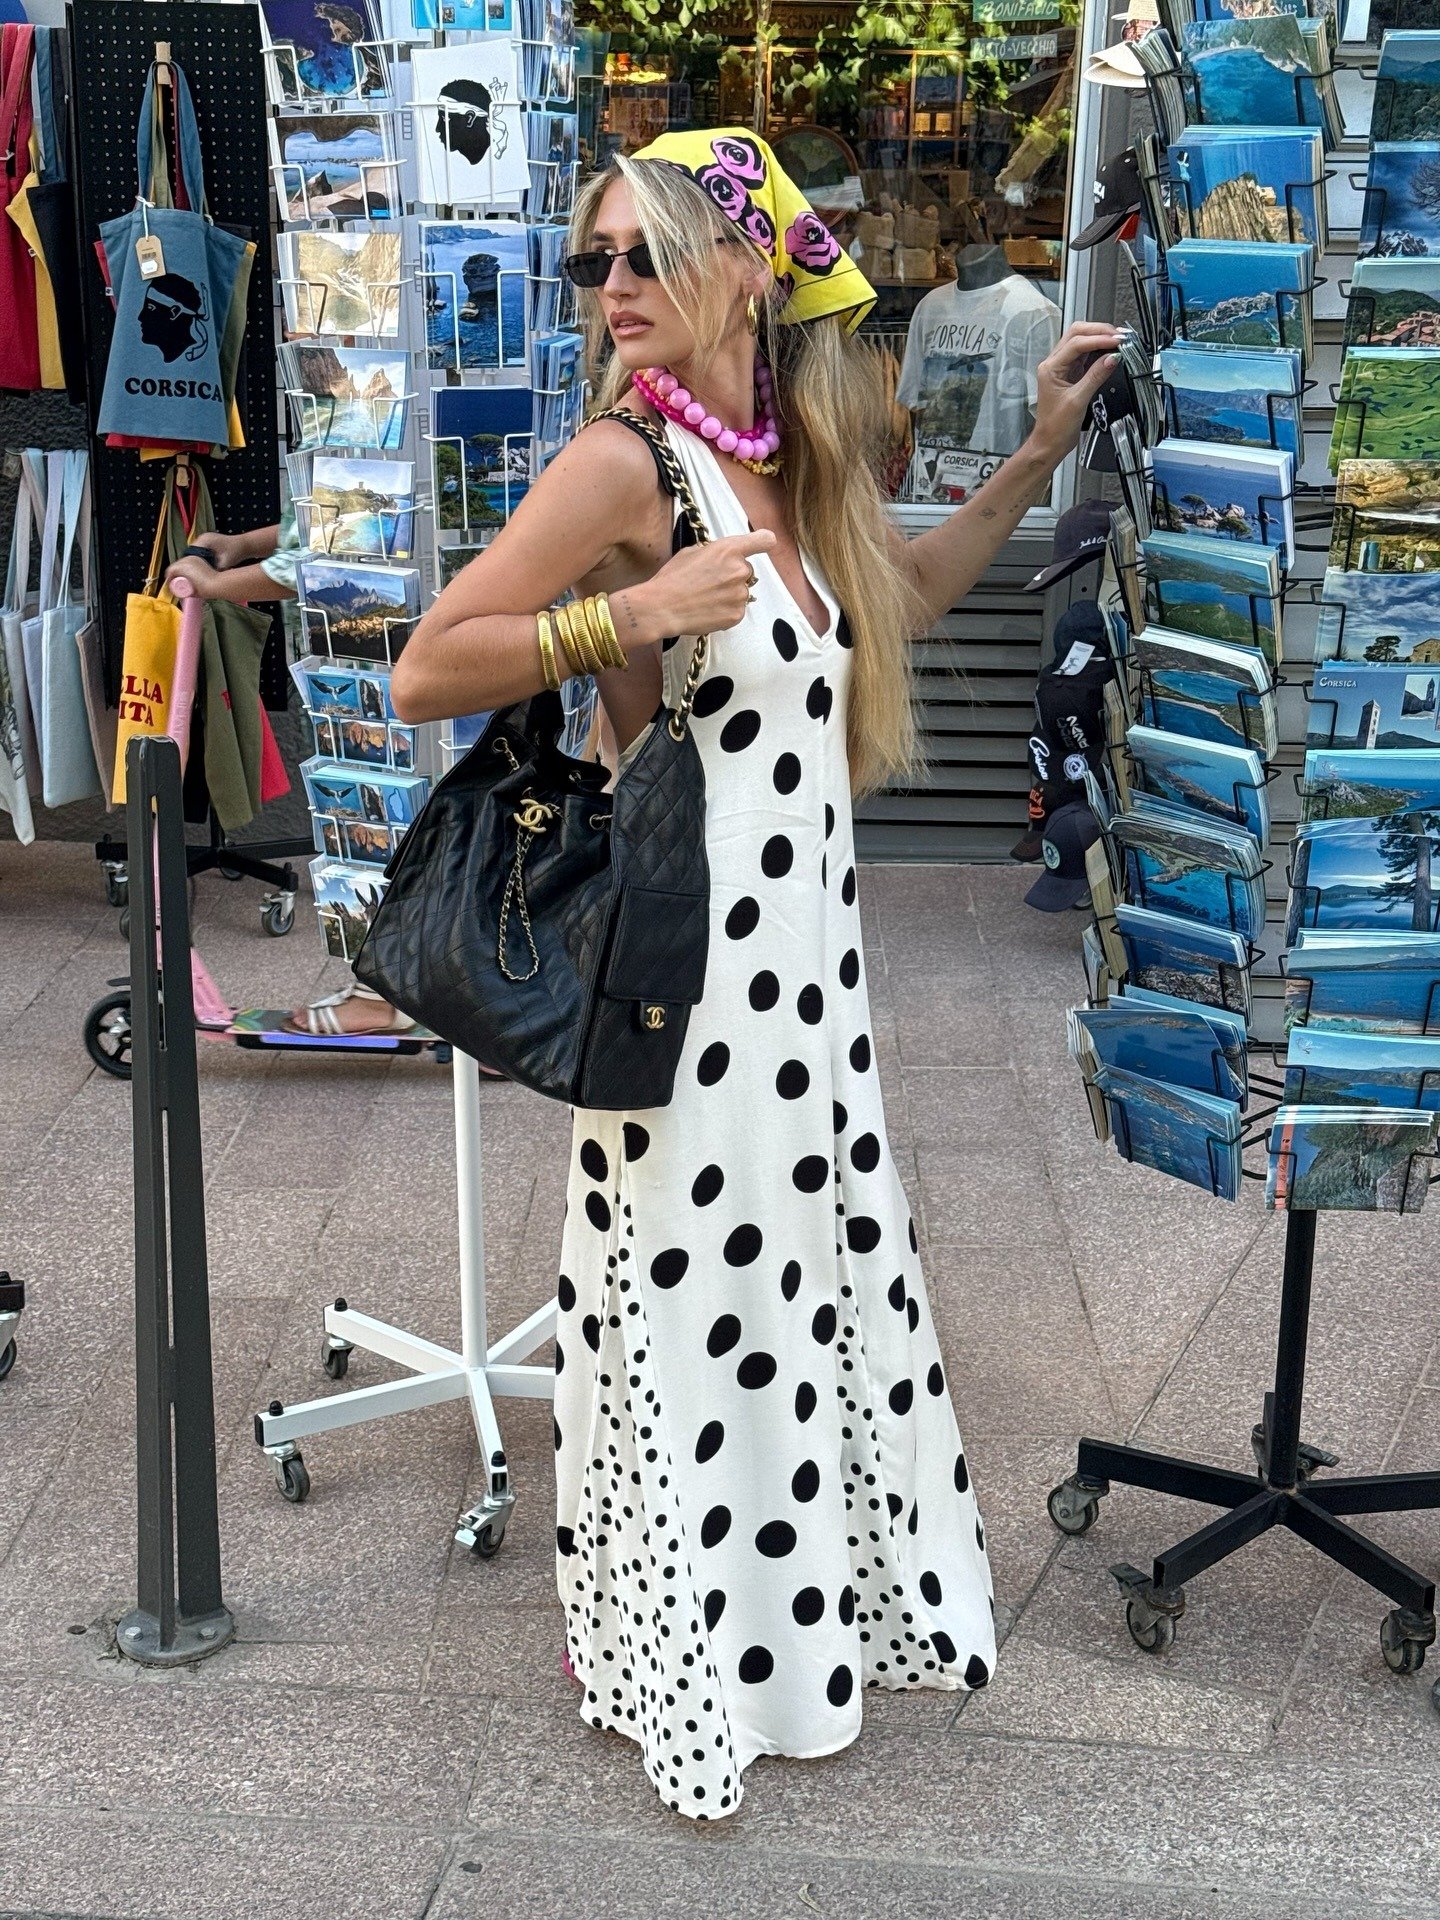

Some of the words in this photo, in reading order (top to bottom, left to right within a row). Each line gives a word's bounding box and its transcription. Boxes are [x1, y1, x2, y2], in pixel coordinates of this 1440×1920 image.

[979, 0, 1055, 20] BONIFACIO
[931, 325, 985, 353] CORSICA
[125, 377, 222, 402] CORSICA
[943, 455, 979, 468] CORSICA
[119, 675, 164, 704] LLA
